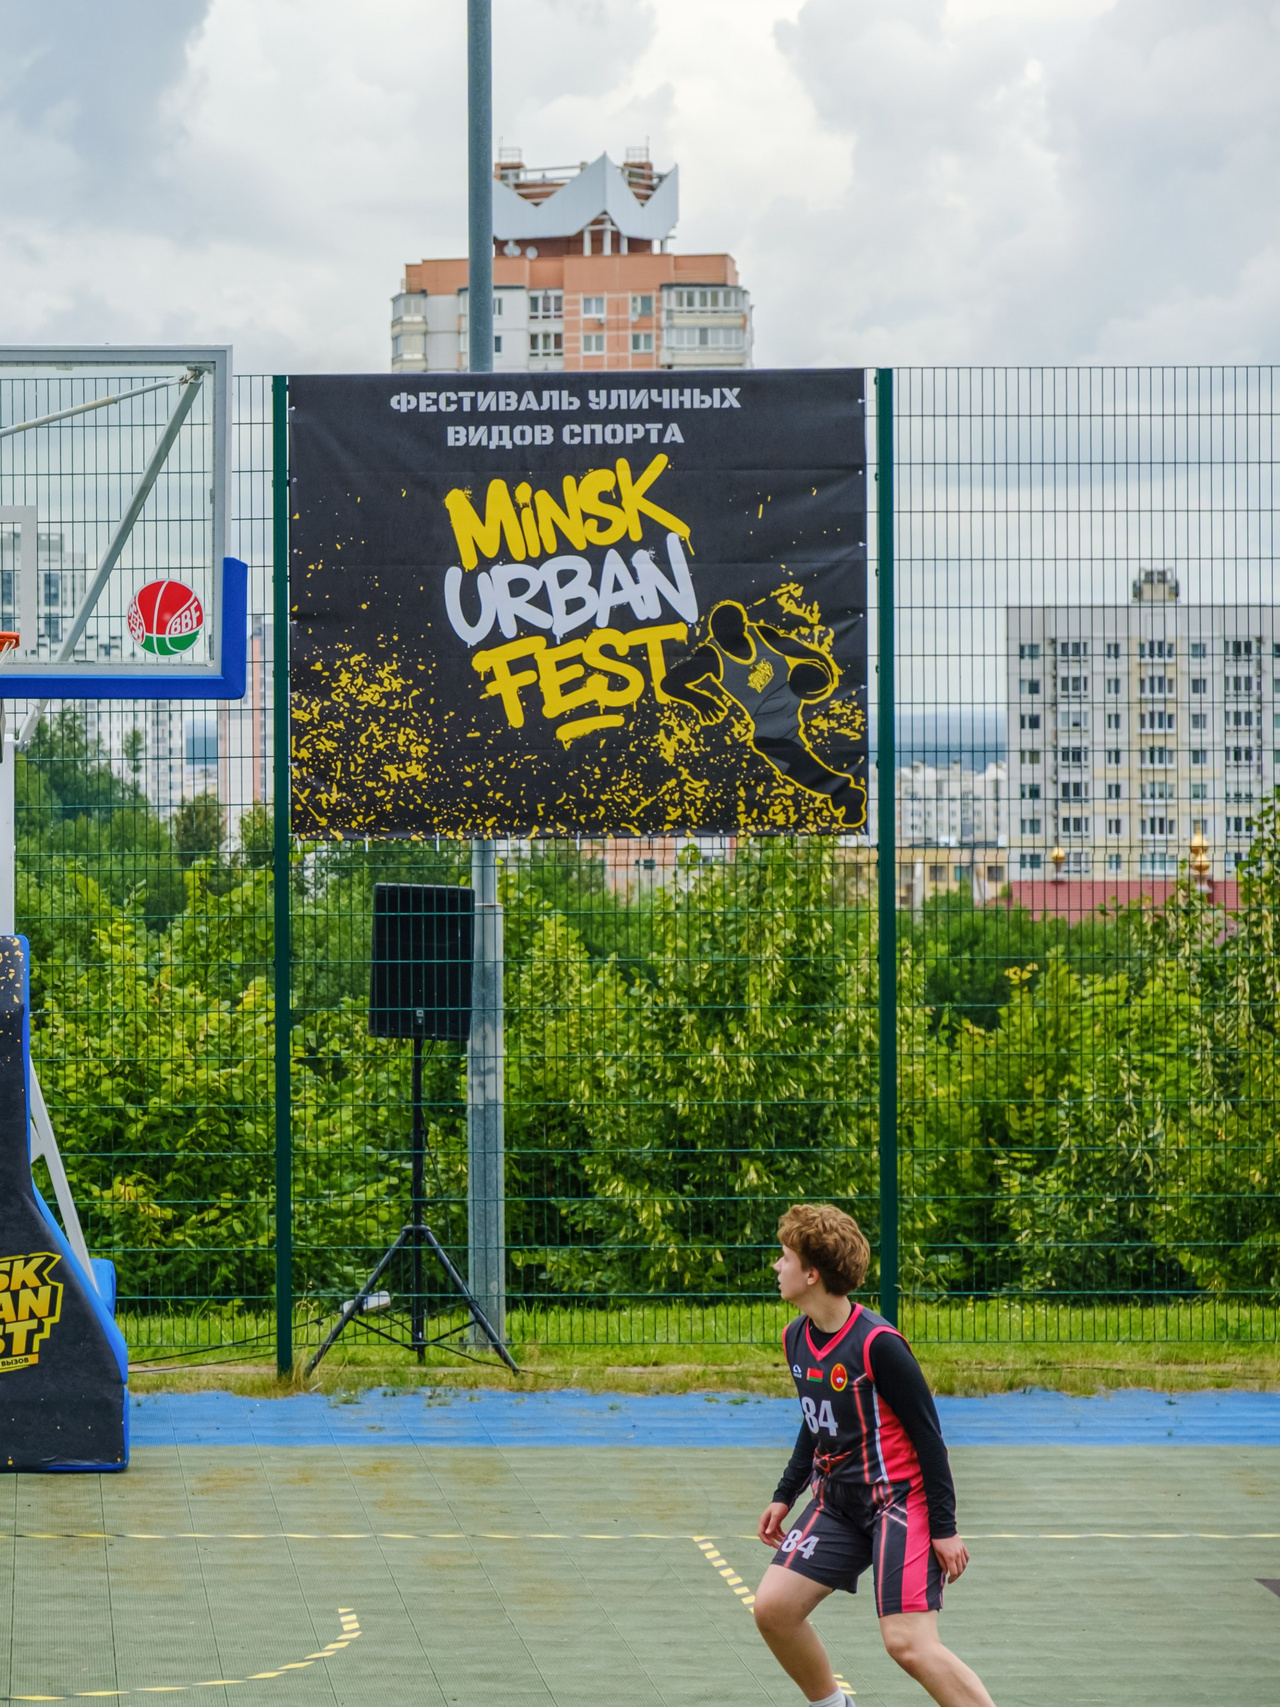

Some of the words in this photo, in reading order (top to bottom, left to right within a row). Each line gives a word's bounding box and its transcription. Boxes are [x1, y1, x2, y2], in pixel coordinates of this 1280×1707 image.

[389, 389, 581, 413] ФЕСТИВАЛЬ
[588, 387, 741, 410] УЛИЧНЫХ
[446, 425, 554, 450] ВИДОВ
[562, 422, 685, 446] СПОРТА
[444, 532, 698, 646] URBAN
[170, 601, 200, 635] BBF
[472, 622, 688, 729] FEST
[1, 1357, 29, 1367] ВЫЗОВ
[801, 1396, 838, 1437] 84
[781, 1529, 820, 1560] 84
